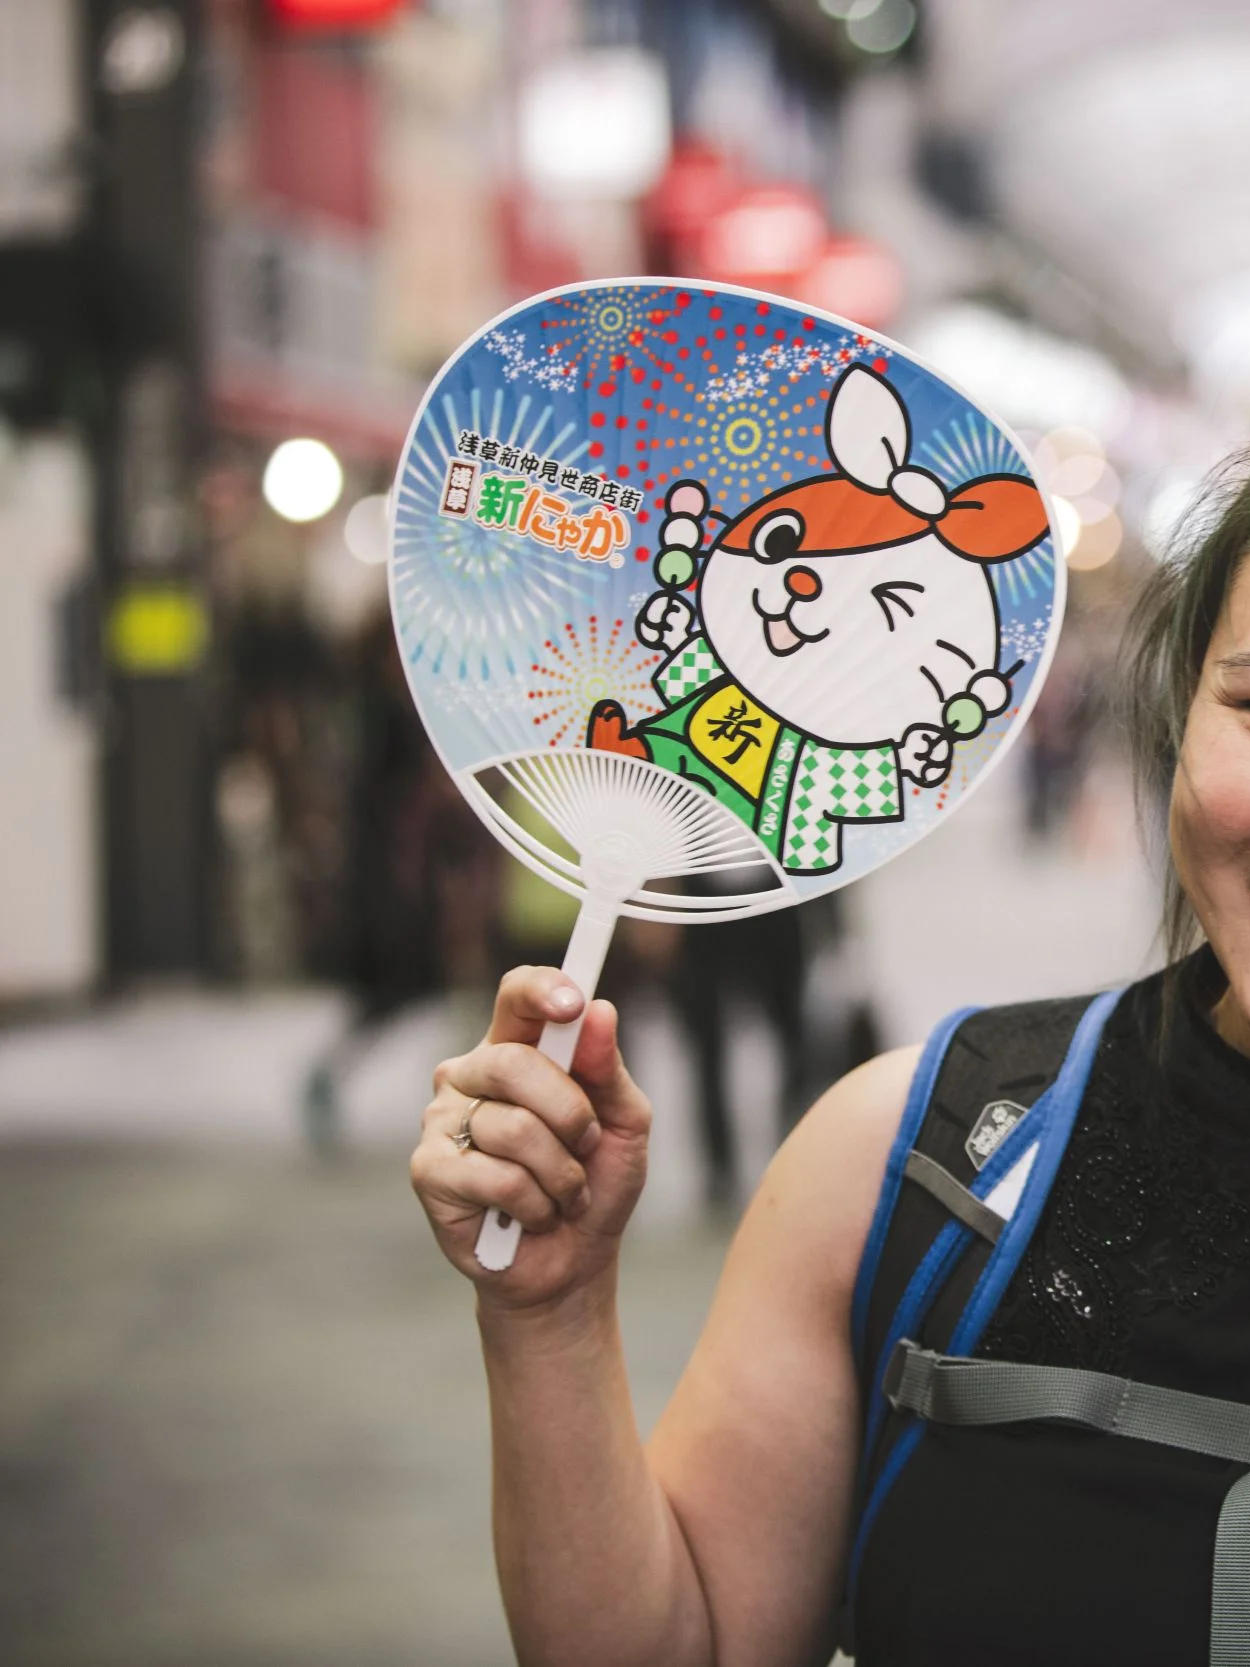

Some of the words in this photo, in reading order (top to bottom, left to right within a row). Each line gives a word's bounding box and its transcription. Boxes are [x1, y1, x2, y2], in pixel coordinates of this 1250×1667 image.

[445, 465, 474, 511] 浅草
[458, 431, 643, 512] 浅草新仲見世商店街
[476, 475, 624, 558] 新にゃか
[706, 699, 762, 765] 新
